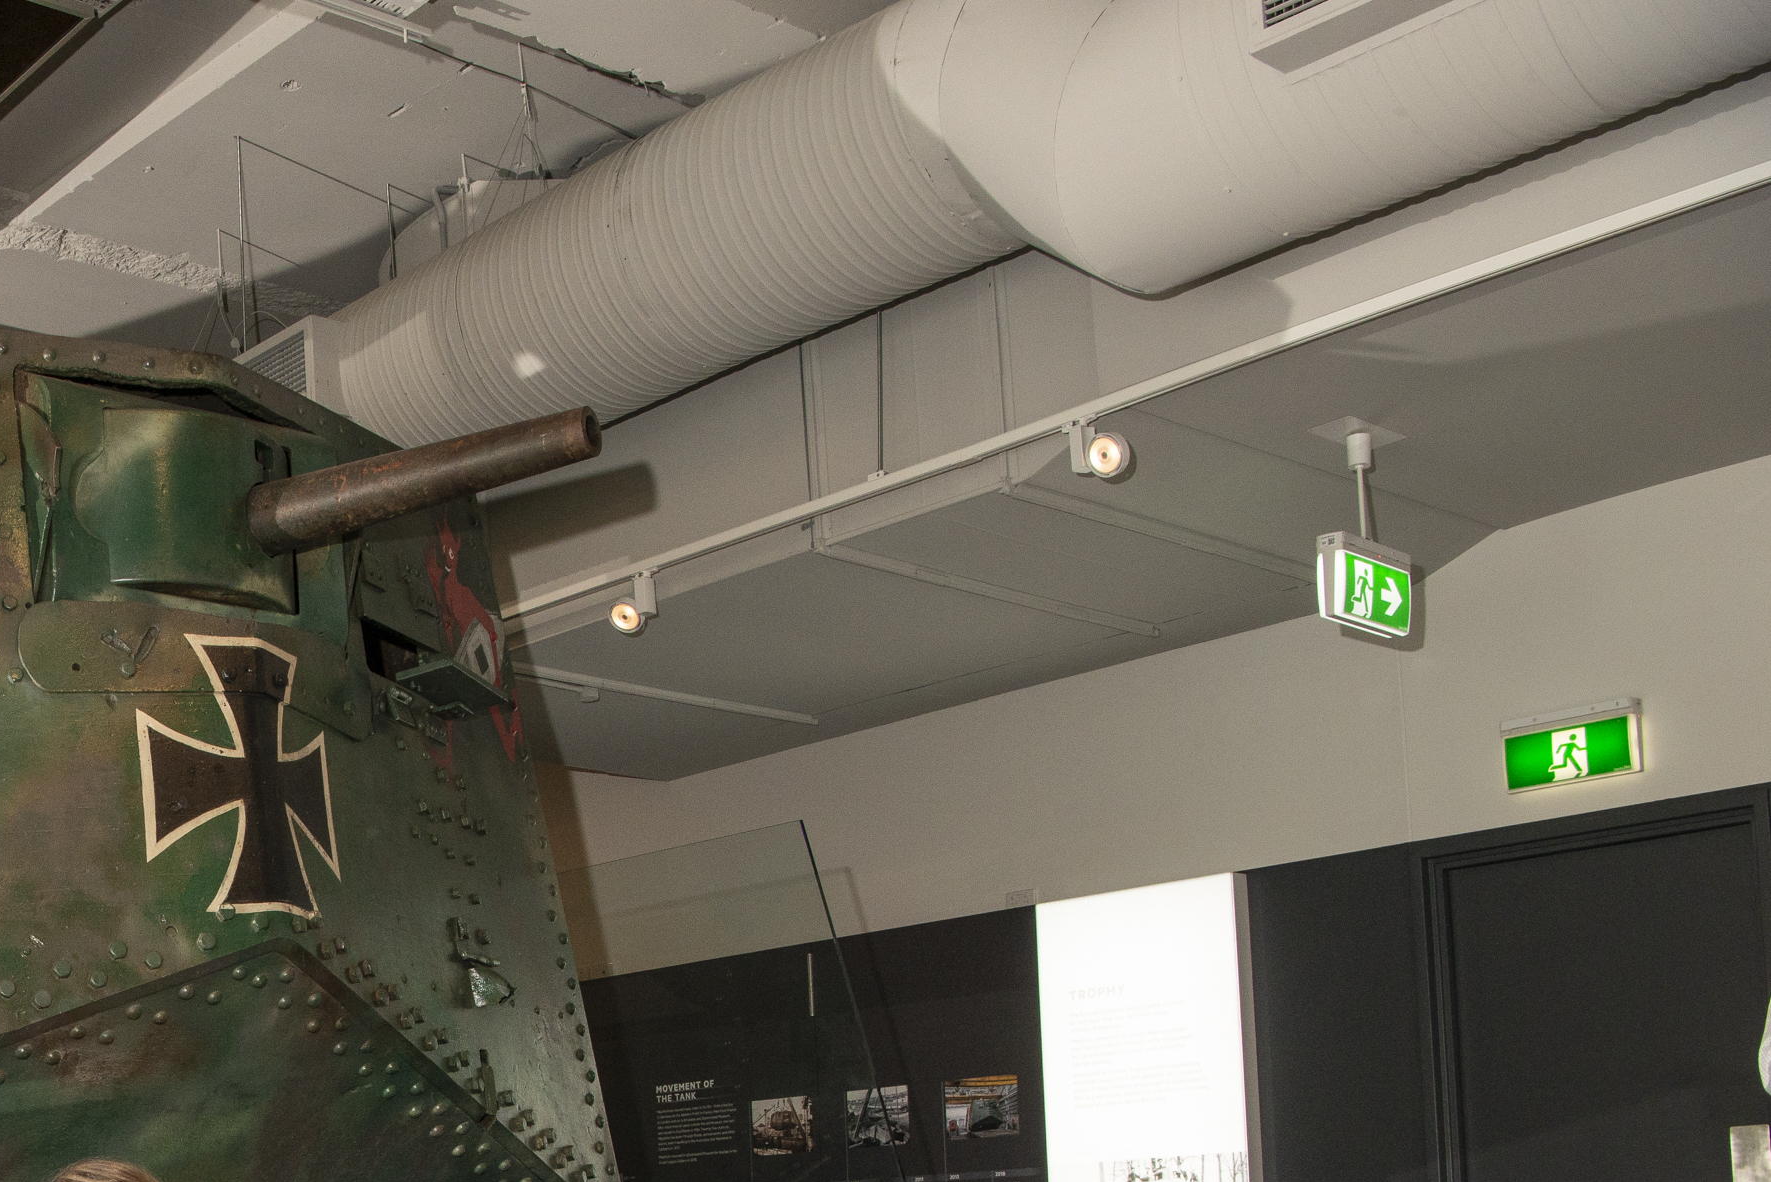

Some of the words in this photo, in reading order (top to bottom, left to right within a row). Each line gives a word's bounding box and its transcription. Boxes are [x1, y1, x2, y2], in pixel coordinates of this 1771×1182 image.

[1069, 984, 1125, 1001] TROPHY
[655, 1081, 701, 1093] MOVEMENT
[703, 1079, 715, 1088] OF
[656, 1095, 673, 1103] THE
[674, 1092, 697, 1102] TANK
